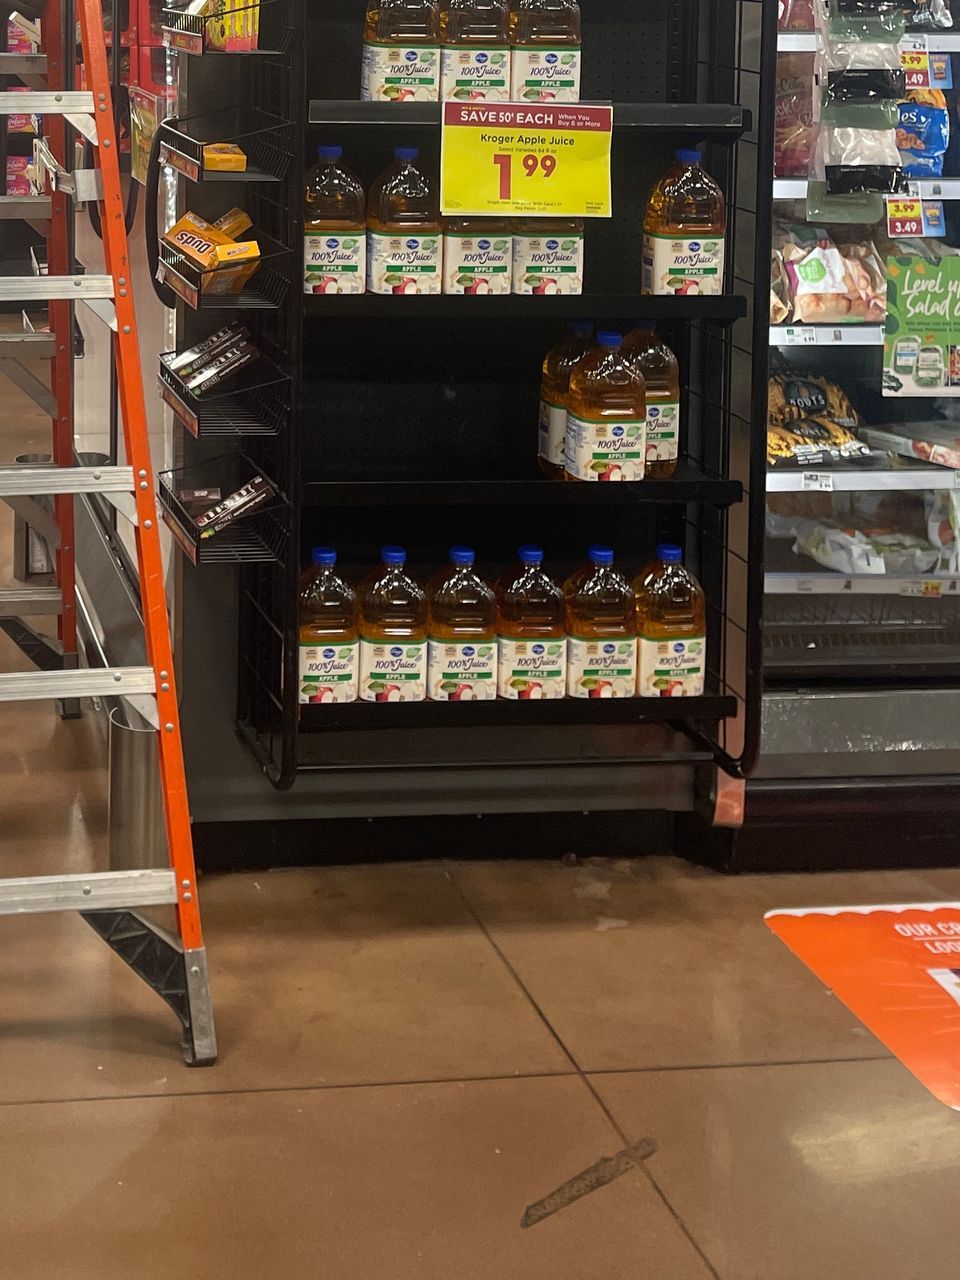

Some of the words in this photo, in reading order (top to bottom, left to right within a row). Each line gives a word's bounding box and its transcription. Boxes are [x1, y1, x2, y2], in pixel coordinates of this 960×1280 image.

[901, 56, 922, 64] 3.99
[460, 110, 496, 122] SAVE
[516, 112, 554, 124] EACH
[578, 114, 590, 122] You
[558, 120, 570, 128] Buy
[480, 134, 514, 144] Kroger
[517, 134, 546, 146] Apple
[549, 136, 575, 146] Juice
[494, 154, 512, 200] 1
[522, 154, 556, 178] 99
[894, 204, 915, 212] 3.99
[896, 222, 918, 233] 3.49
[901, 270, 944, 296] Level
[906, 292, 952, 320] Salad
[894, 923, 938, 937] OUR
